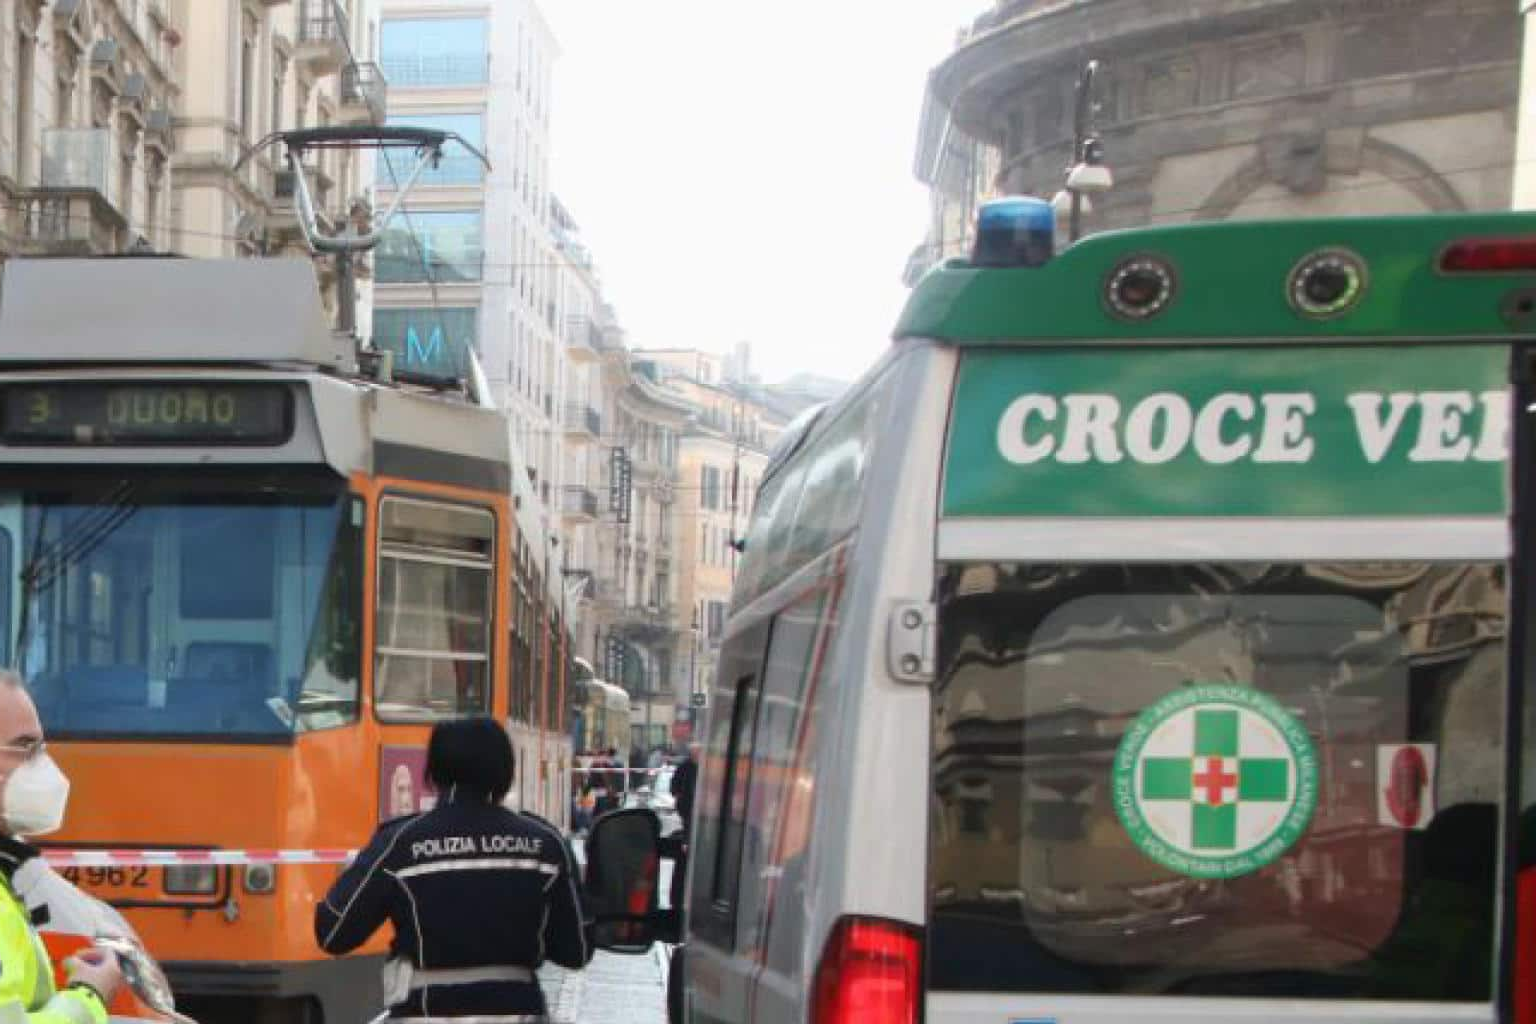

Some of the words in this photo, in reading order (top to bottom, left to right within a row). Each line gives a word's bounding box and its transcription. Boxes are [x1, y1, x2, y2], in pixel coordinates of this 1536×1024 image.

[28, 391, 51, 423] 3
[107, 389, 236, 424] DUOMO
[996, 392, 1317, 464] CROCE
[412, 836, 476, 860] POLIZIA
[481, 834, 545, 854] LOCALE
